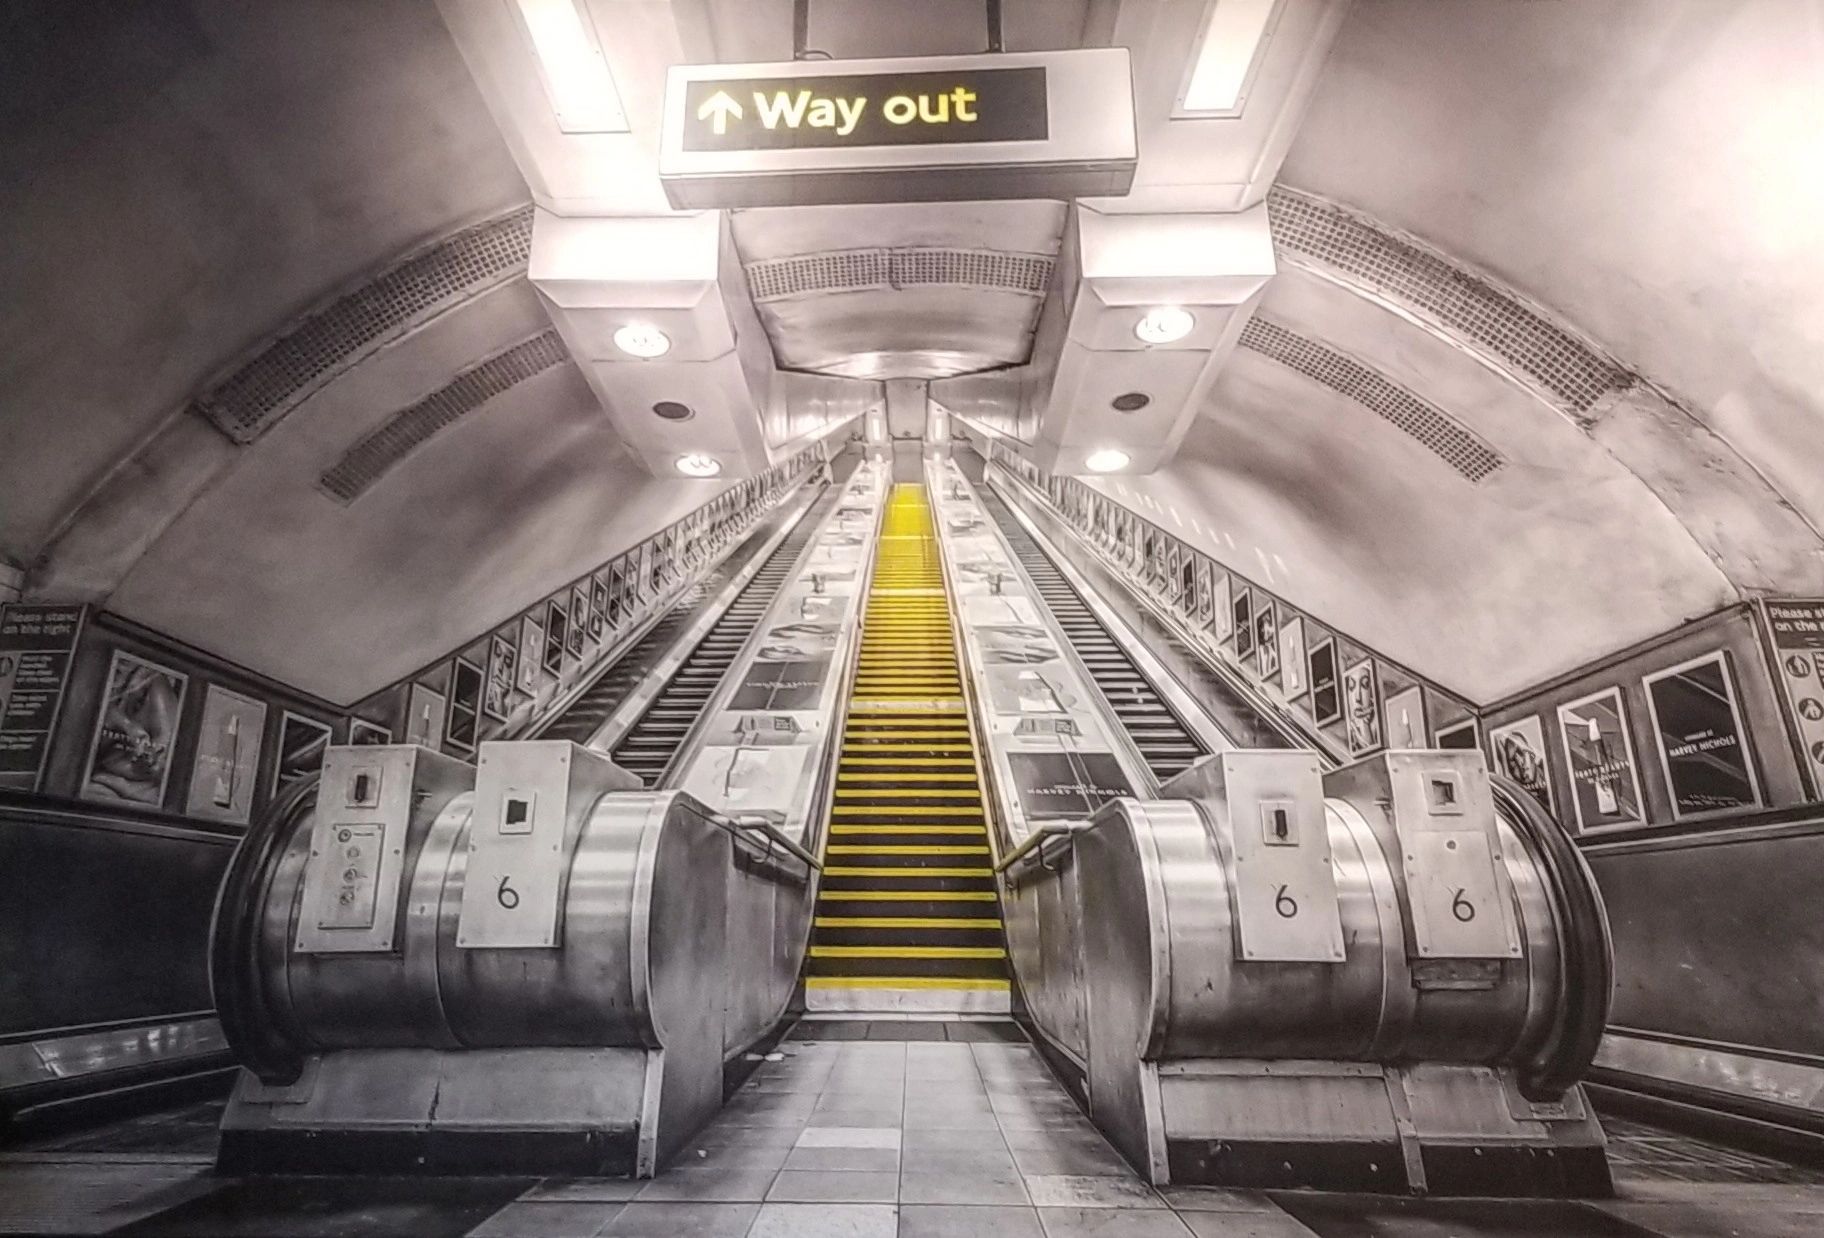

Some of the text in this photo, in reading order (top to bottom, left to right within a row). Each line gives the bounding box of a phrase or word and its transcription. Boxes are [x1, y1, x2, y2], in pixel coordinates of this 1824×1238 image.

[753, 87, 978, 135] Way out
[6, 612, 42, 623] ease
[1769, 606, 1813, 619] Please
[1774, 621, 1794, 632] on
[1793, 620, 1819, 632] the
[497, 875, 520, 909] 6
[1275, 884, 1298, 918] 6
[1452, 888, 1476, 922] 6
